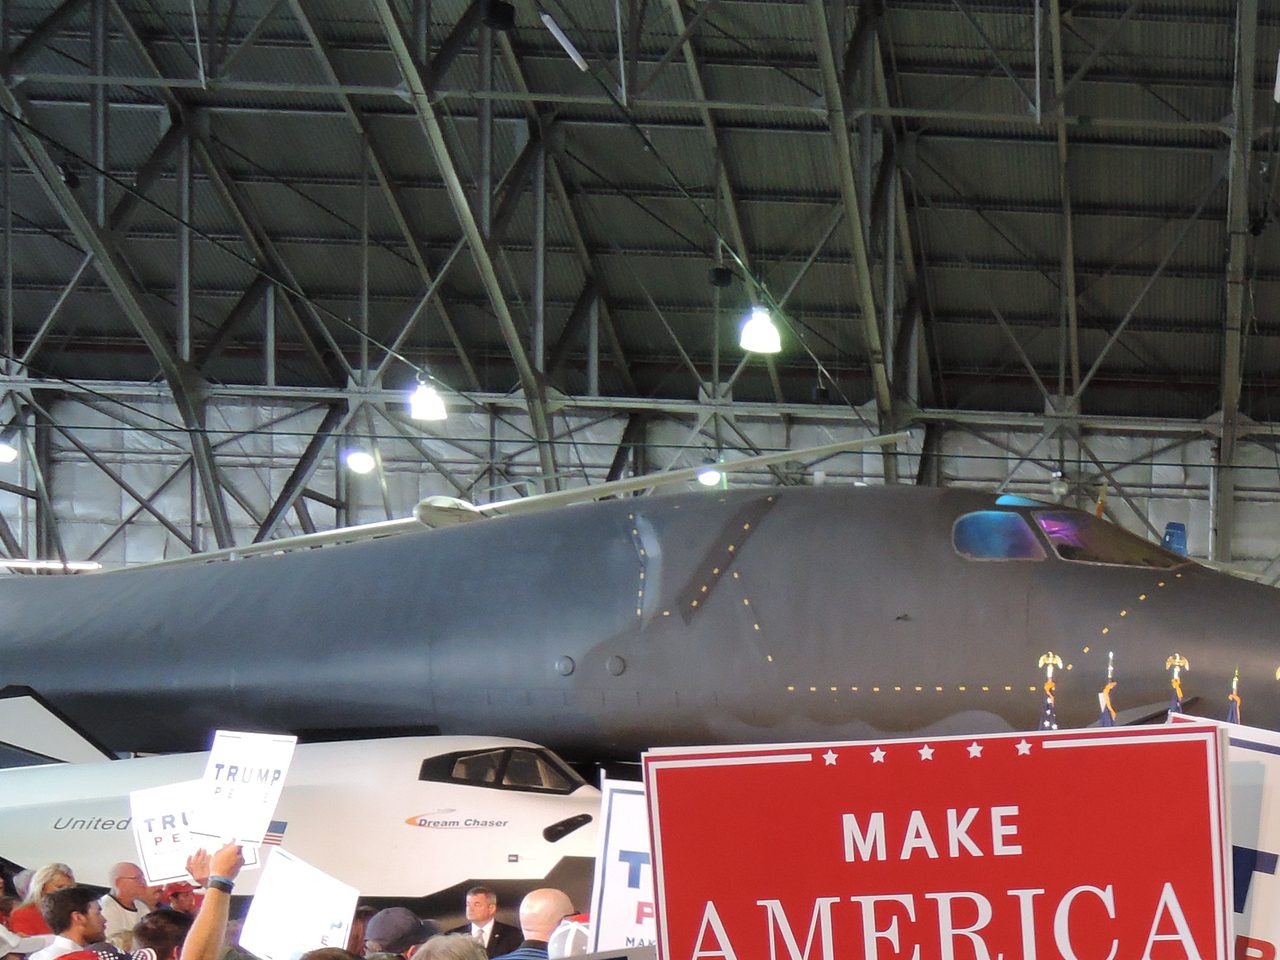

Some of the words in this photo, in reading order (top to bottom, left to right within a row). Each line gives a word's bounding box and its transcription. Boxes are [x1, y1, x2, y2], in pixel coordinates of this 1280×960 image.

[215, 763, 282, 786] TRUMP
[53, 816, 132, 831] United
[418, 818, 460, 827] Dream
[464, 818, 509, 827] Chaser
[842, 805, 1023, 862] MAKE
